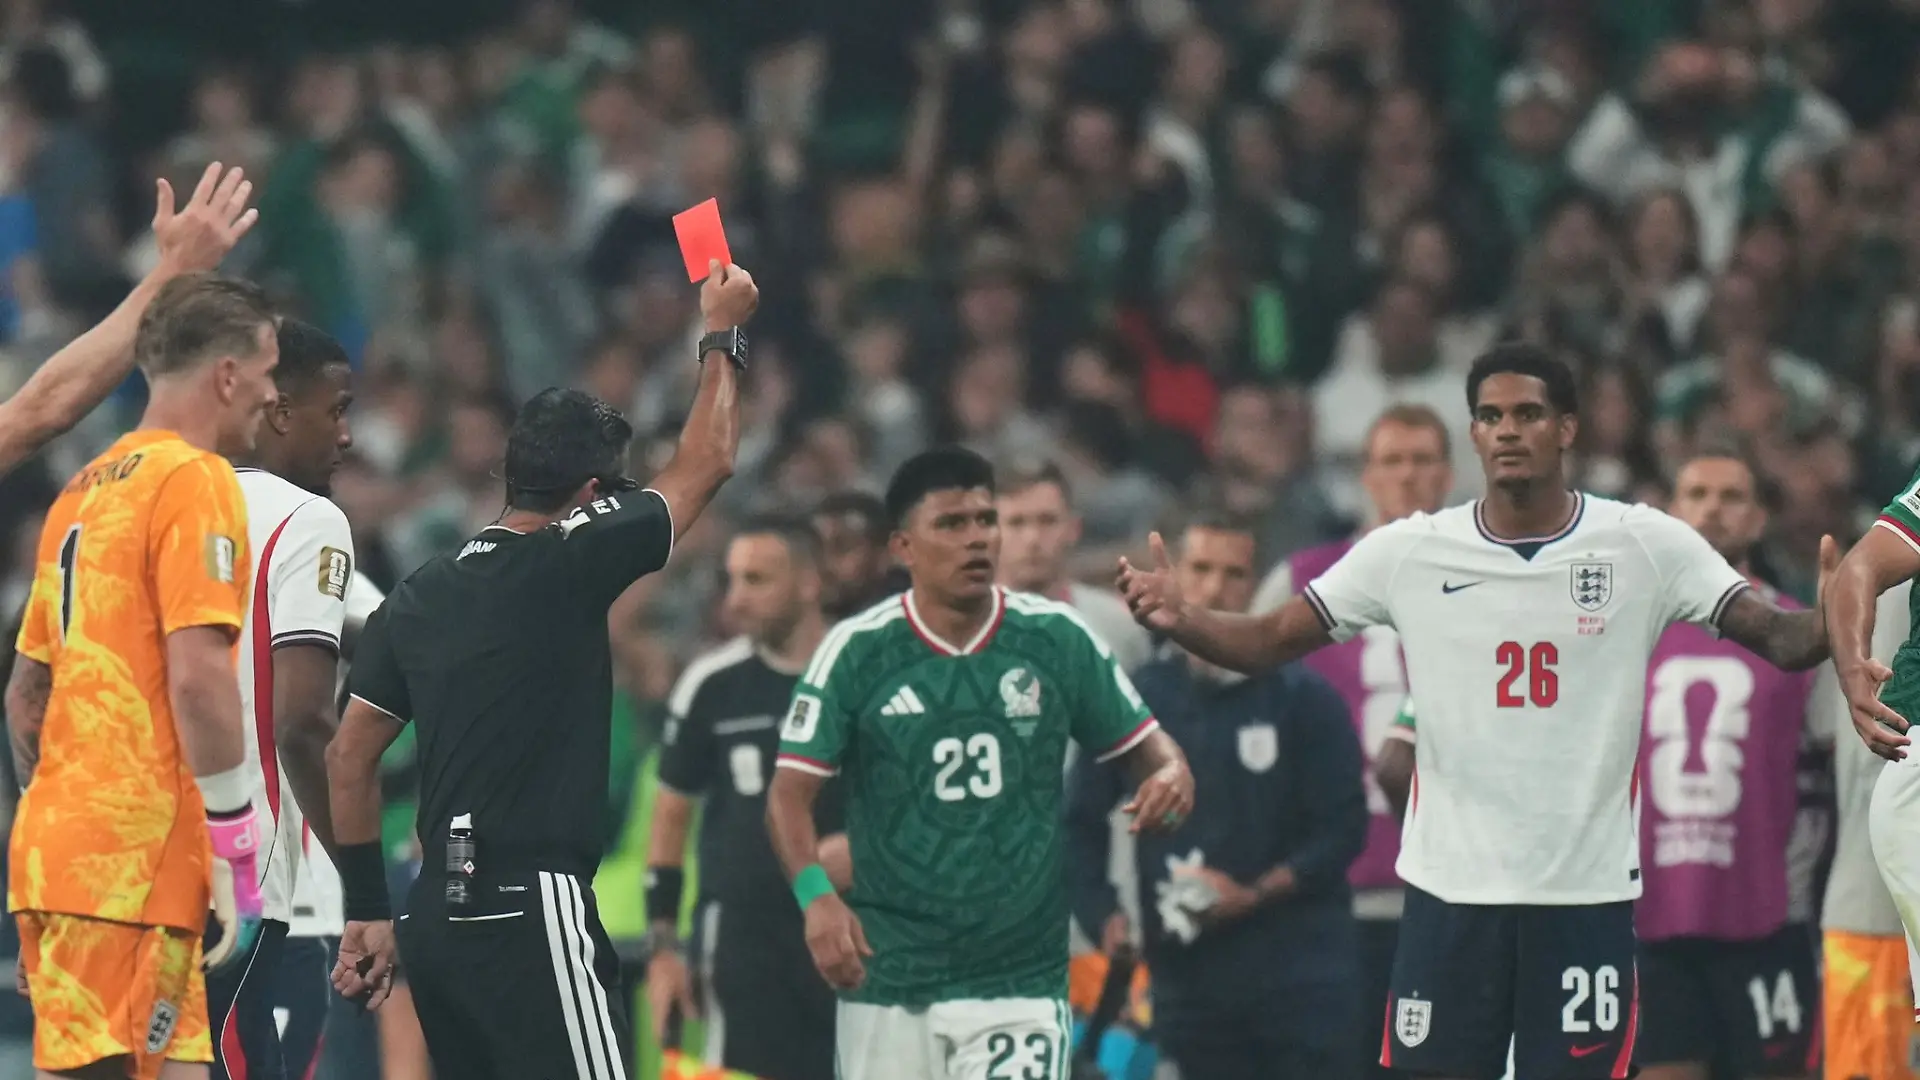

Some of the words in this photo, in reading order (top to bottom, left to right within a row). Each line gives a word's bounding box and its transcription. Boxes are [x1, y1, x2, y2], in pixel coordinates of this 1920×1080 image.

[60, 523, 82, 647] 1
[1496, 641, 1558, 708] 26
[932, 732, 1002, 801] 23
[1562, 965, 1619, 1032] 26
[1748, 968, 1801, 1039] 14
[986, 1032, 1052, 1080] 23
